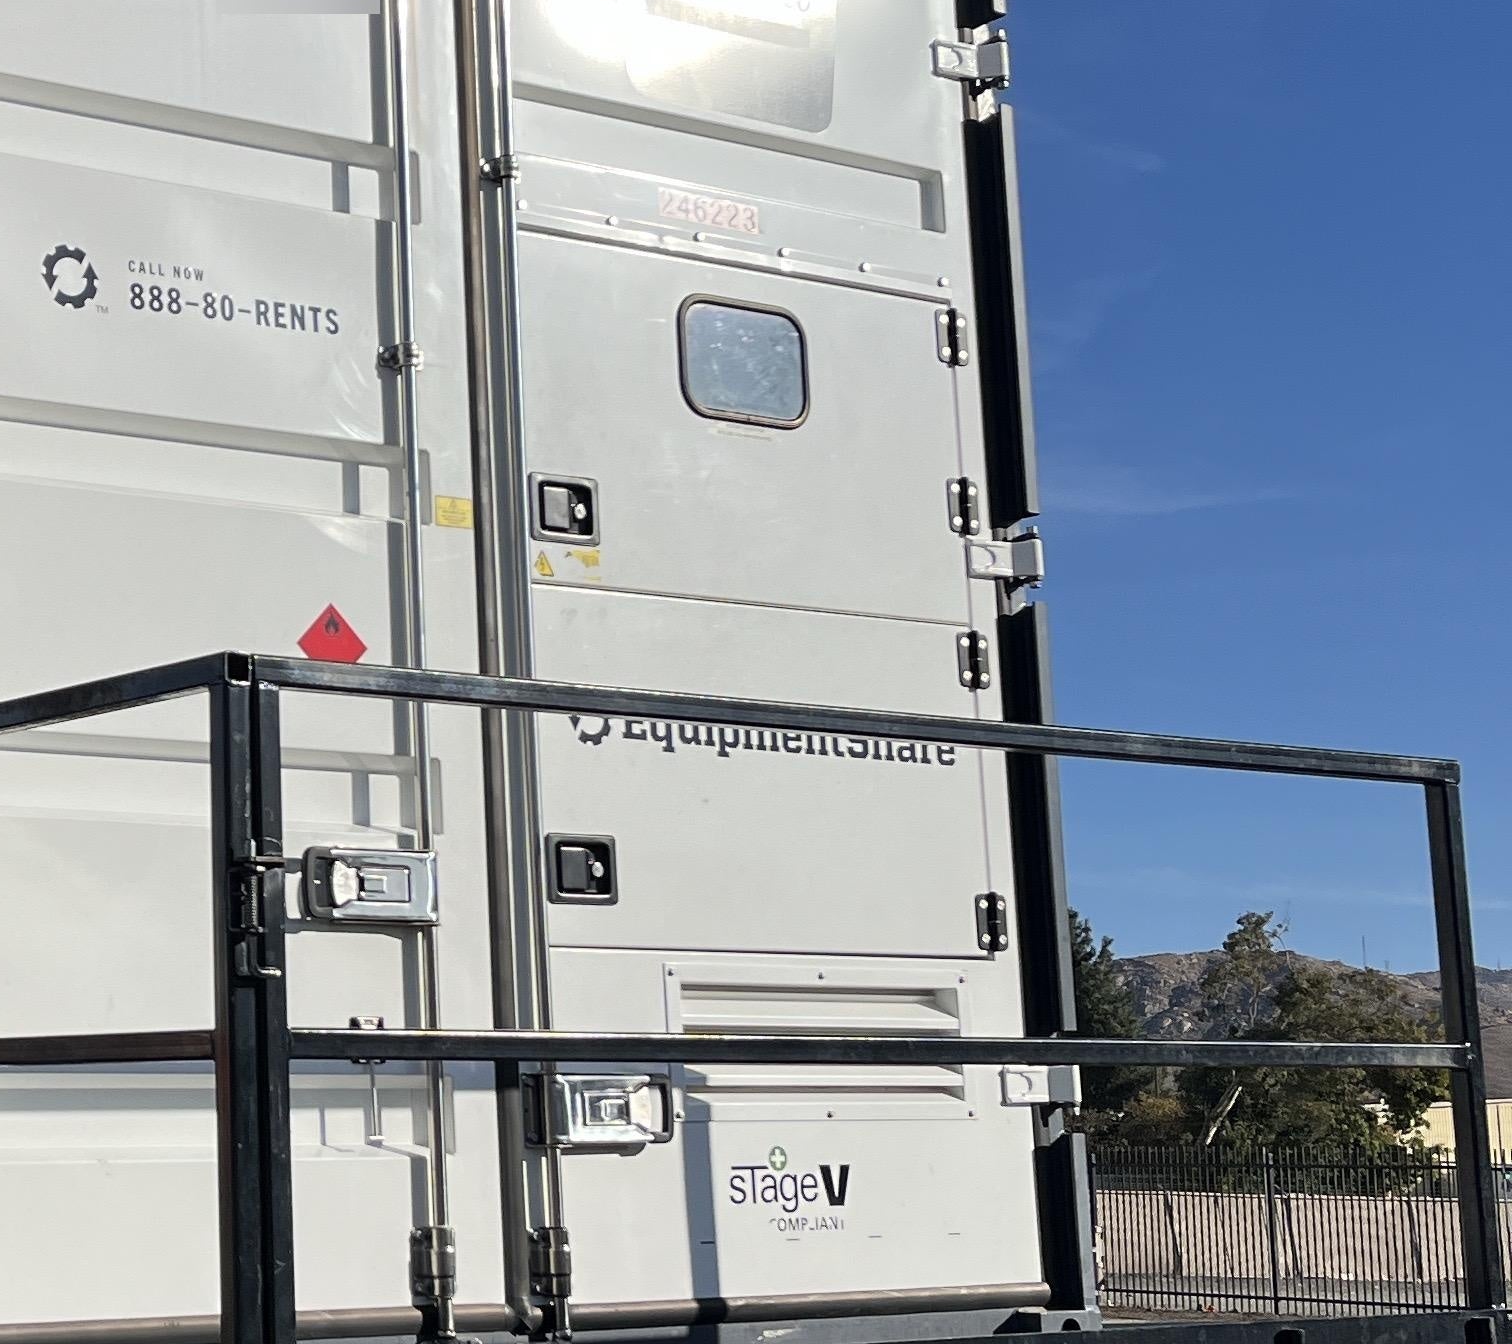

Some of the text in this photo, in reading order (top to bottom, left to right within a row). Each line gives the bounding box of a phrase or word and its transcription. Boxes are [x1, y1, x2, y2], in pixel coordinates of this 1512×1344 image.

[659, 191, 757, 234] 246223
[127, 259, 205, 282] CALL NOW
[129, 282, 340, 336] 888-80-RENTS
